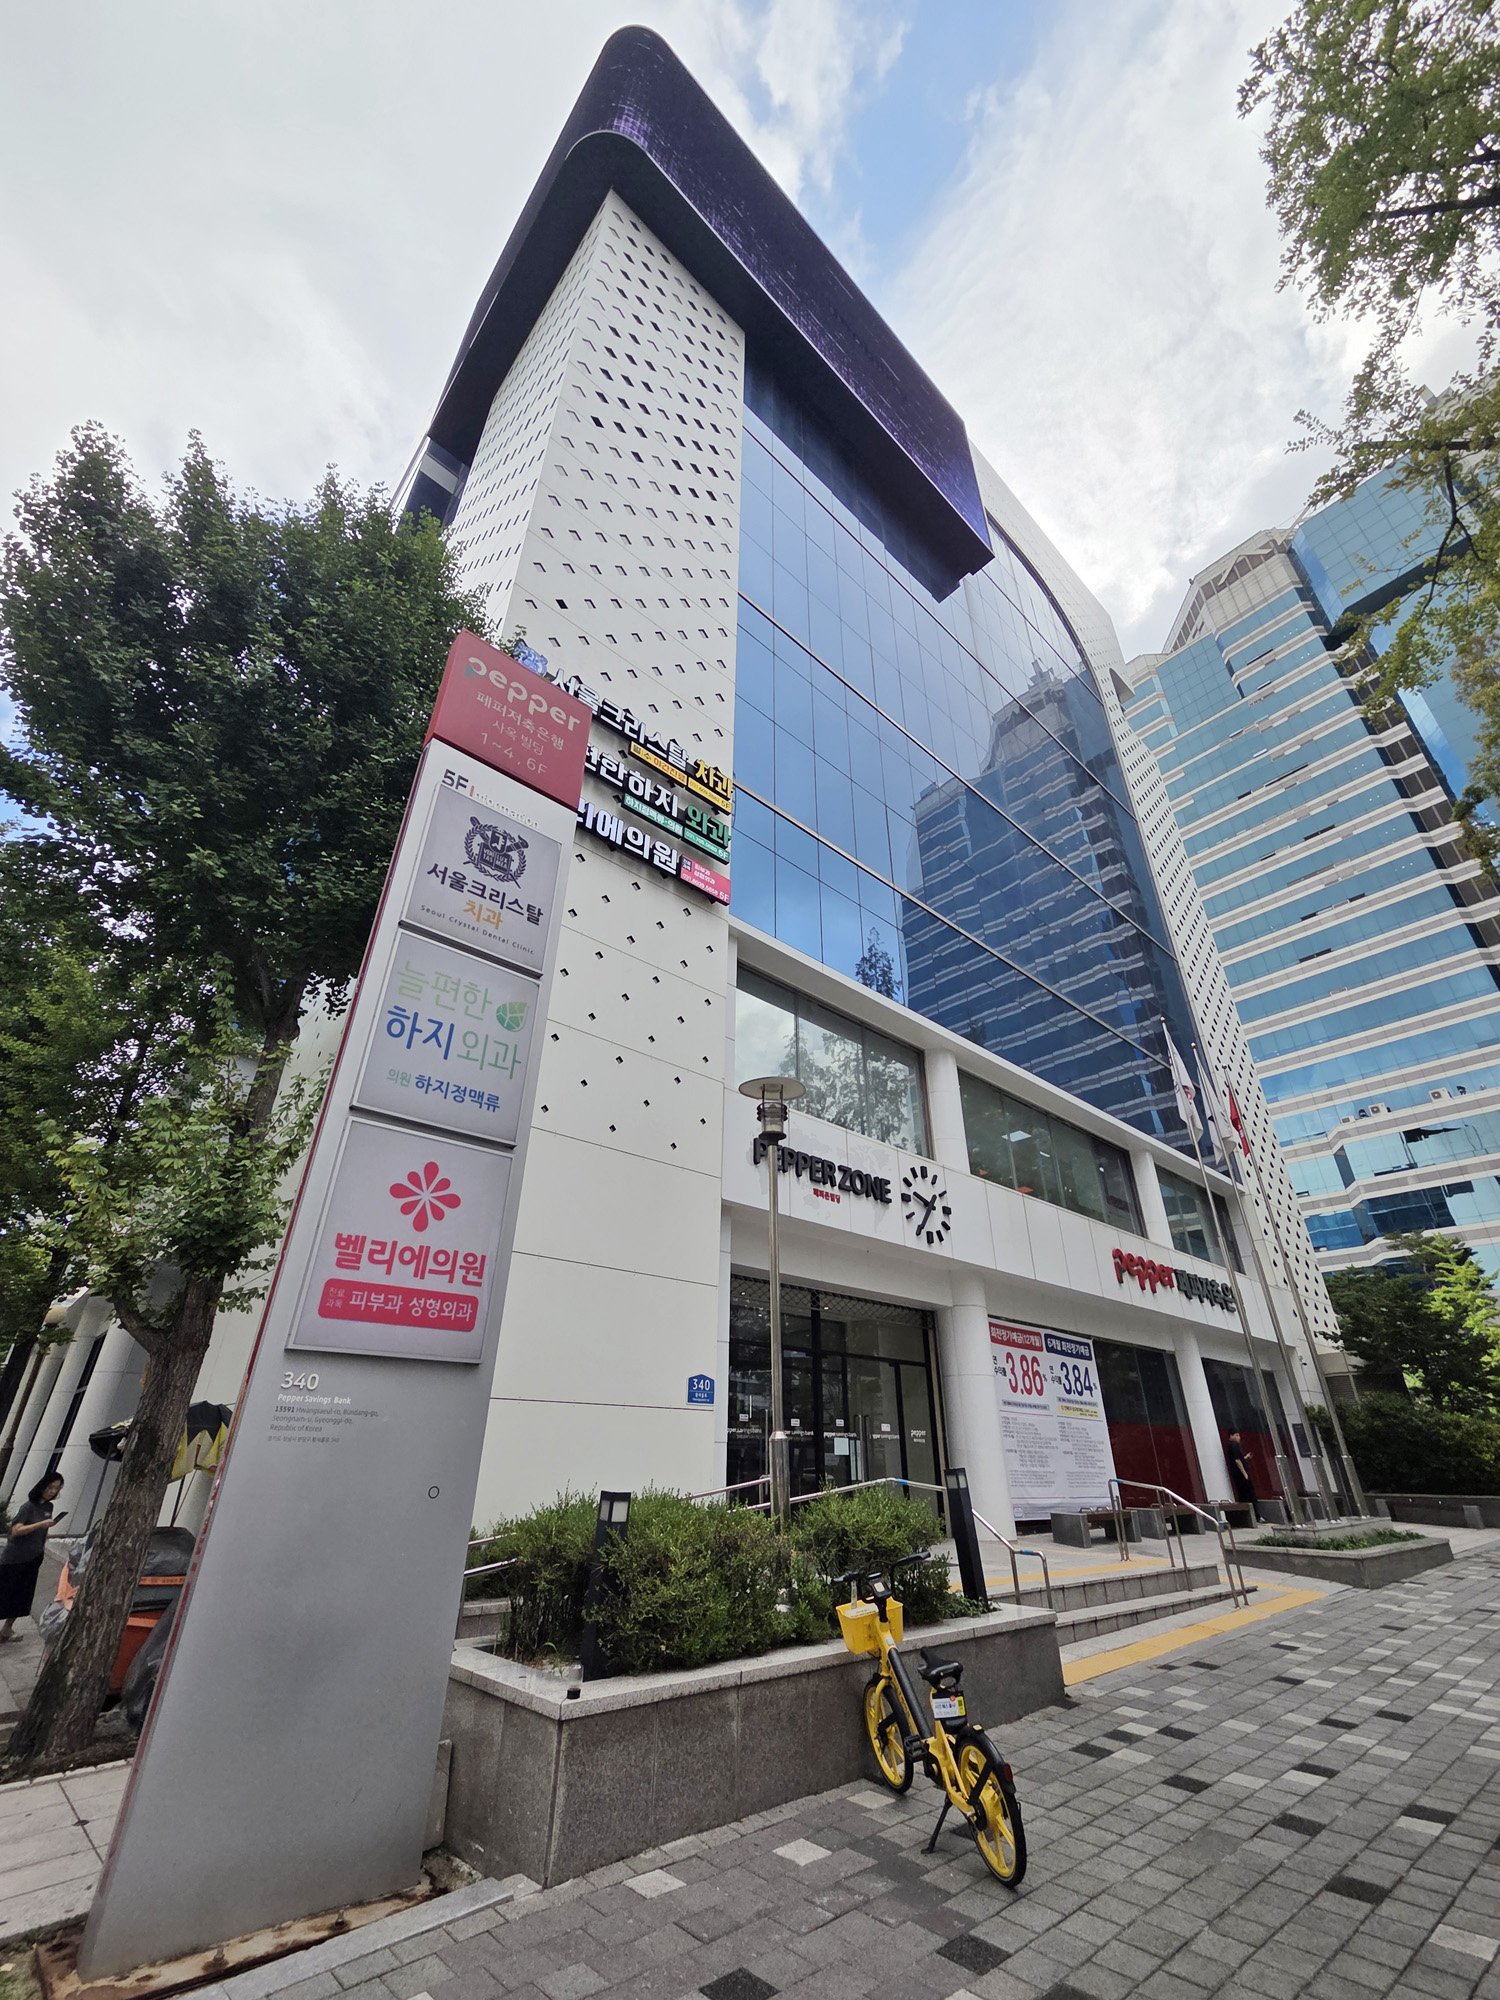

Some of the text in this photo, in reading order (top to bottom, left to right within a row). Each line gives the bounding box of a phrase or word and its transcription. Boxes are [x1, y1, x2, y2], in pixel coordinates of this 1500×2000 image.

[465, 657, 580, 731] pepper
[476, 691, 564, 750] 페퍼저축은행
[492, 720, 544, 756] 사옥 빌딩
[441, 768, 469, 790] 5F
[695, 759, 733, 800] 치과
[685, 805, 731, 847] 외과
[427, 863, 544, 926] 서울크리스탈
[464, 900, 504, 930] 치과
[420, 904, 534, 955] Seoul Crystal Dental Clinic
[397, 960, 492, 1021] 늘편한
[387, 1068, 501, 1112] 의원 하지정맥류
[837, 1164, 892, 1204] ZONE
[334, 1233, 487, 1287] 벨리에의원
[1112, 1248, 1175, 1294] pepper
[349, 1290, 473, 1322] 피부과 성형외과
[1174, 1269, 1236, 1313] 페퍼저축은
[278, 1393, 351, 1405] Pepper Savings Bank
[280, 1371, 320, 1390] 340
[693, 1378, 710, 1391] 340
[270, 1424, 296, 1432] Republic
